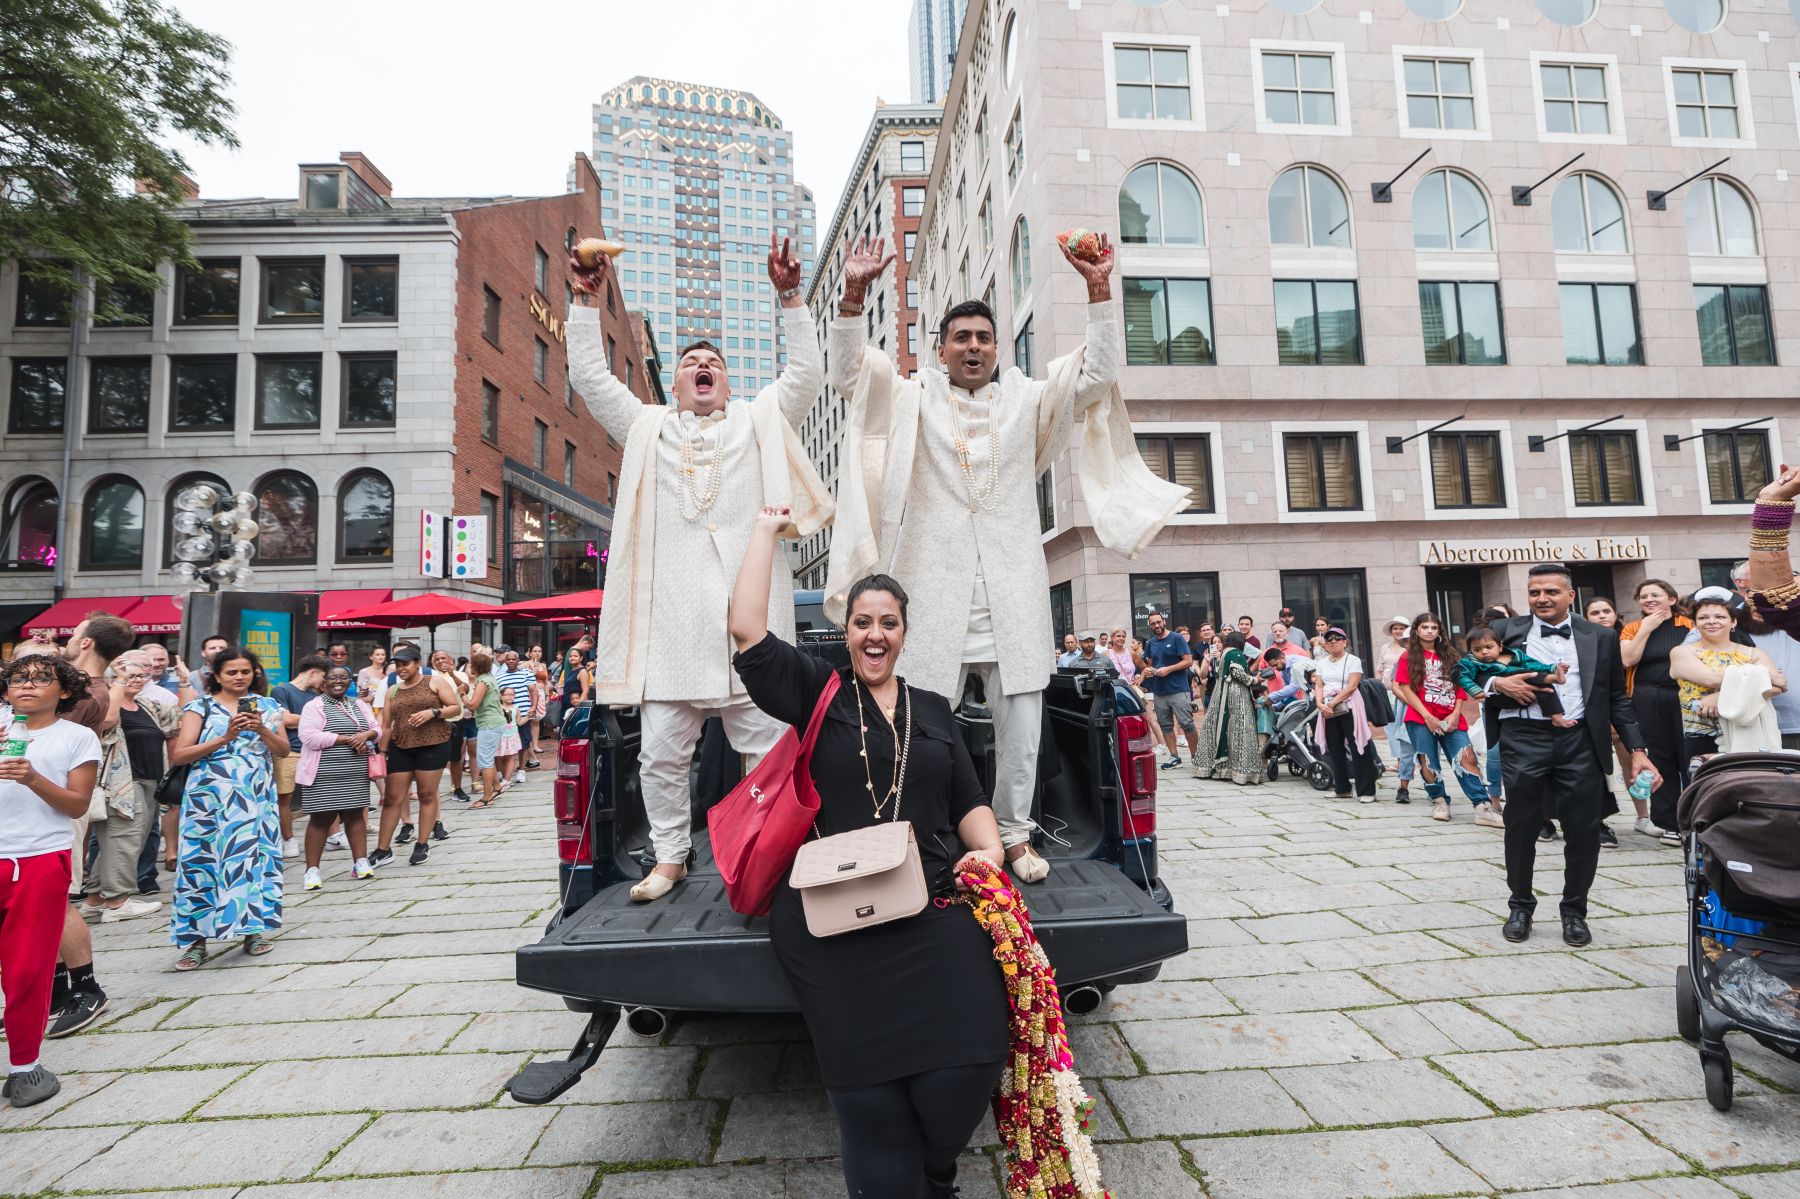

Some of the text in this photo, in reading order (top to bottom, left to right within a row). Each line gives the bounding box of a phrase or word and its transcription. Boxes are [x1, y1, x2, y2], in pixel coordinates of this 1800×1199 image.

[469, 519, 477, 575] SUGAR
[1425, 537, 1649, 563] Abercrombie & Fitch
